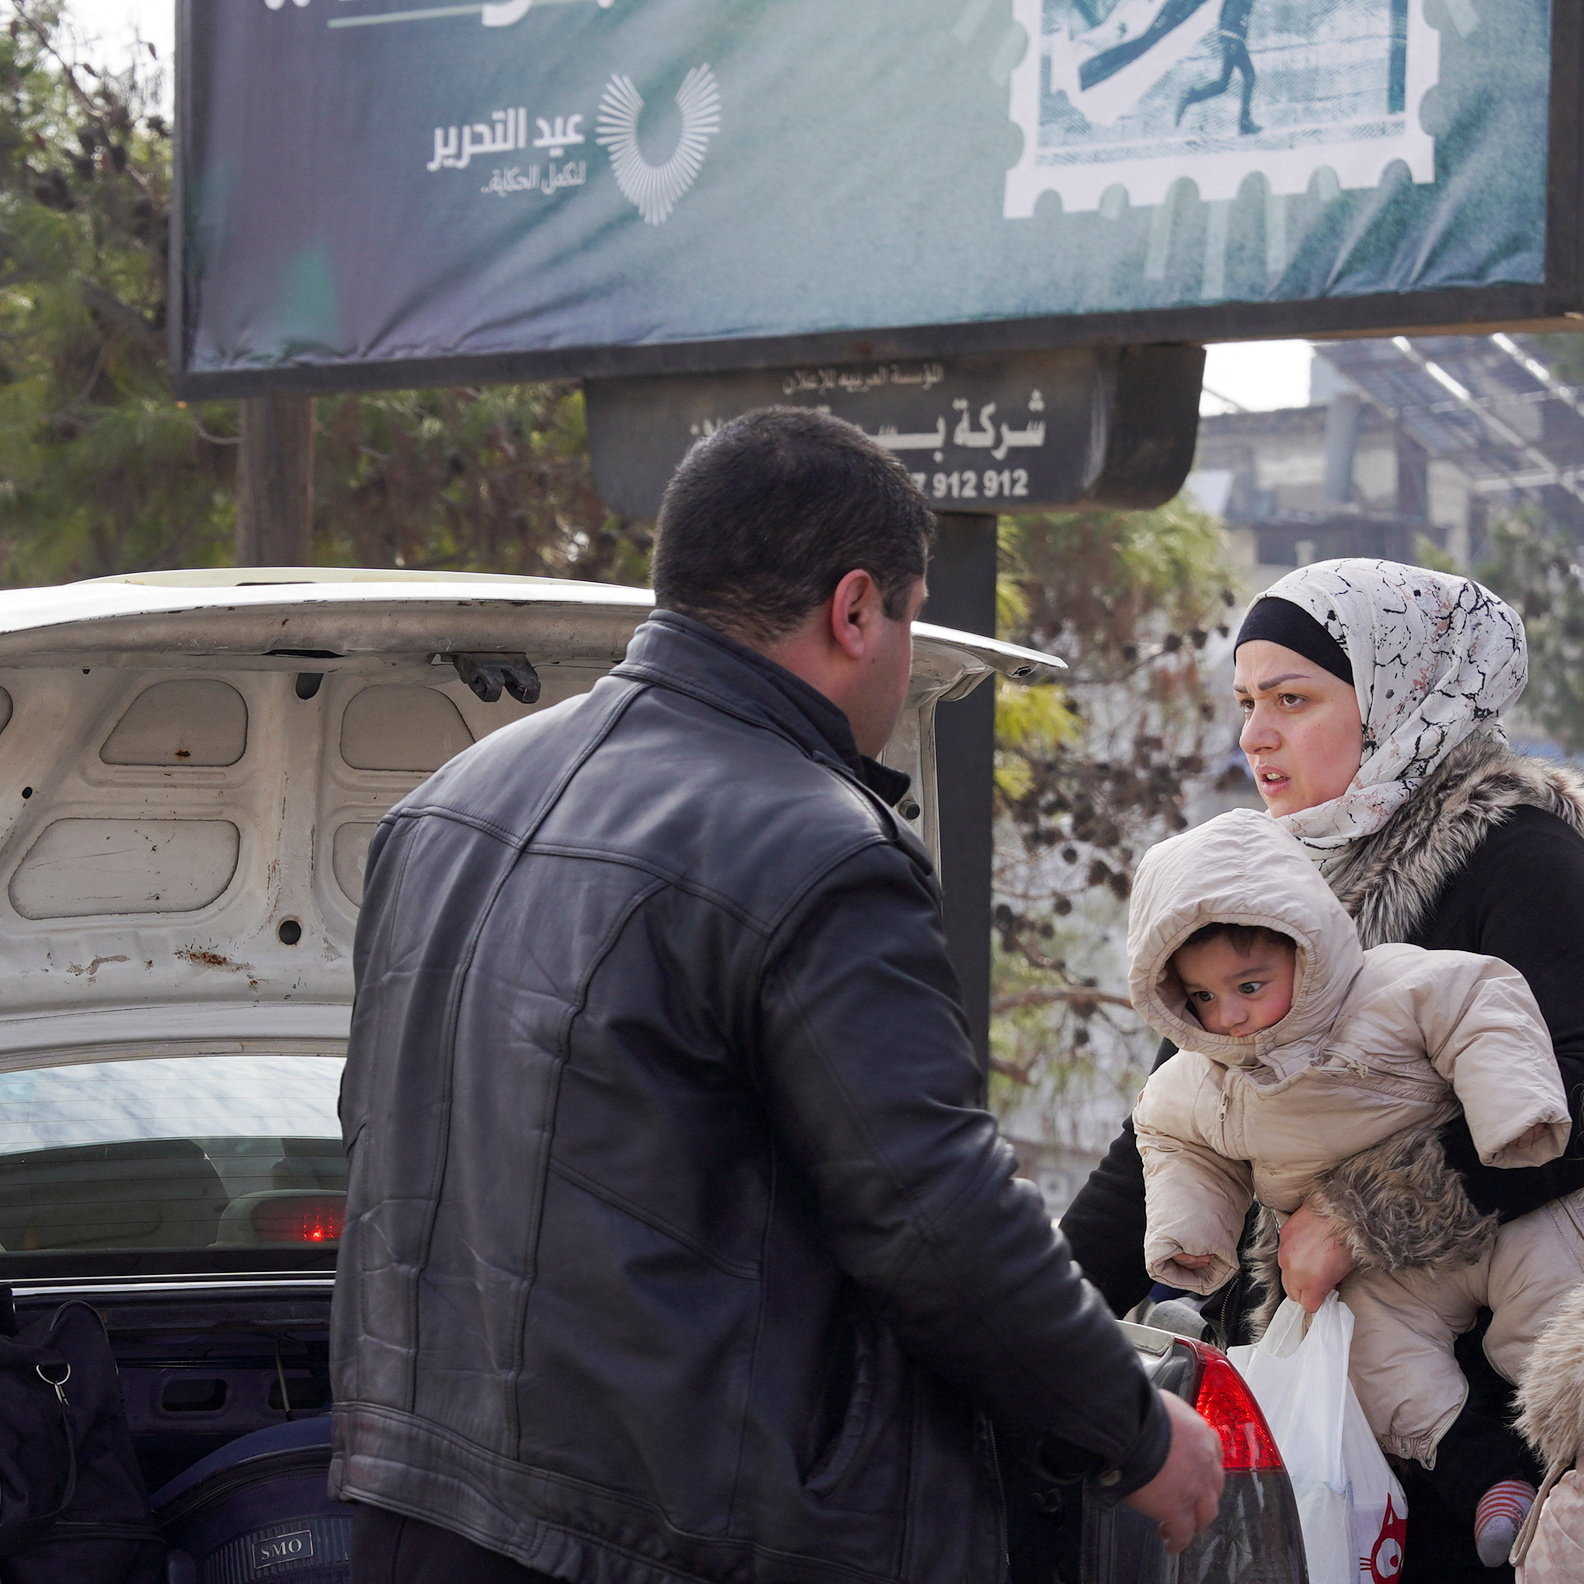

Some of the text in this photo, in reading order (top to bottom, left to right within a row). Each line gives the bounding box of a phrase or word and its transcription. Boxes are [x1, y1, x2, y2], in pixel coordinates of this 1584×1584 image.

[426, 106, 585, 172] عيد التحرير
[951, 388, 1046, 461] شركة
[932, 469, 978, 499] 912
[982, 467, 1029, 498] 912
[261, 1538, 303, 1561] SMO
